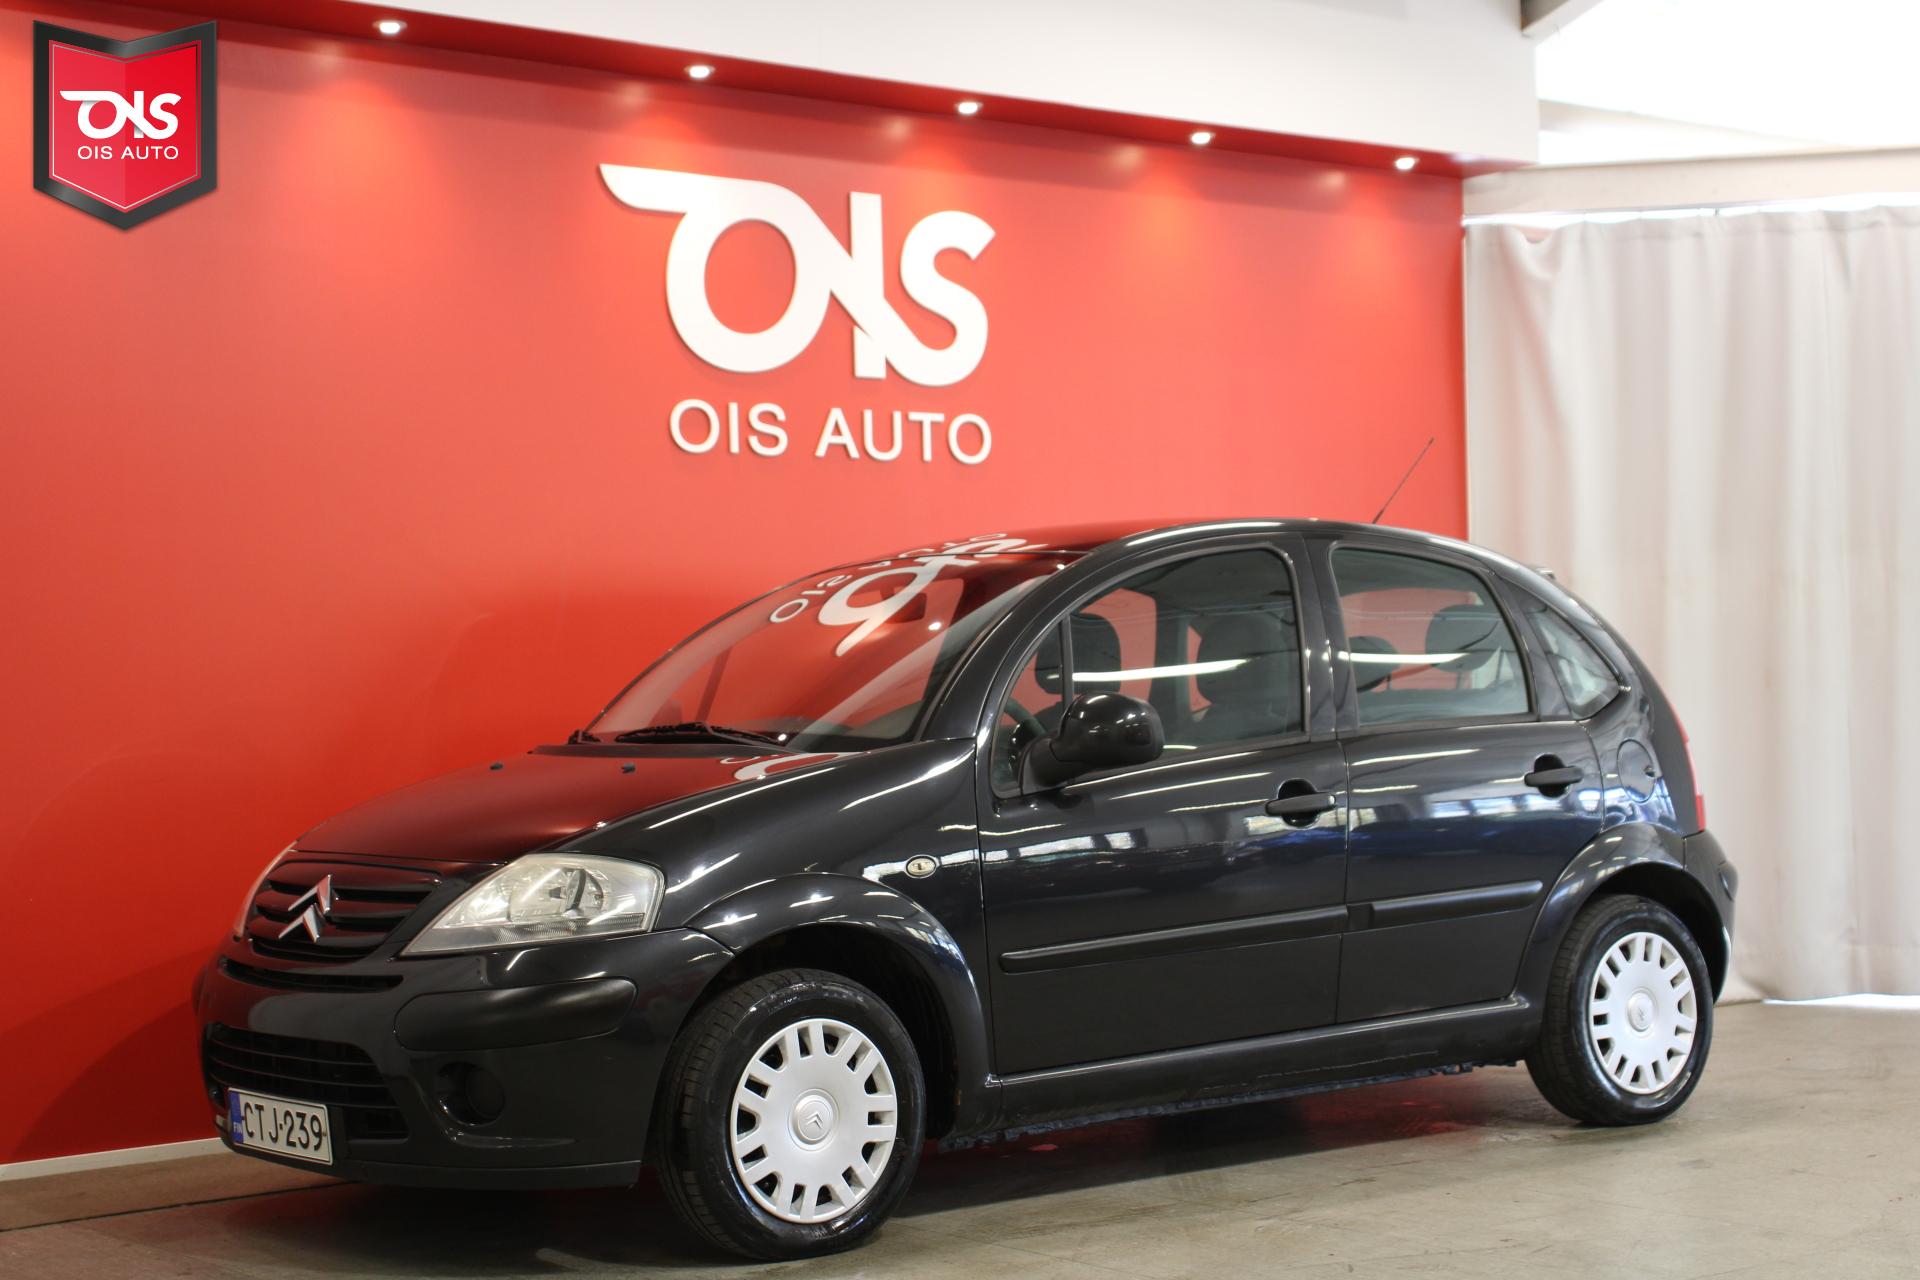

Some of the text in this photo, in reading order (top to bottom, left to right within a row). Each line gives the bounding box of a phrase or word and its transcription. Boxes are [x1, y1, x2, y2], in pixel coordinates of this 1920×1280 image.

[669, 398, 992, 465] OIS AUTO
[244, 1101, 322, 1151] CTJ-239
